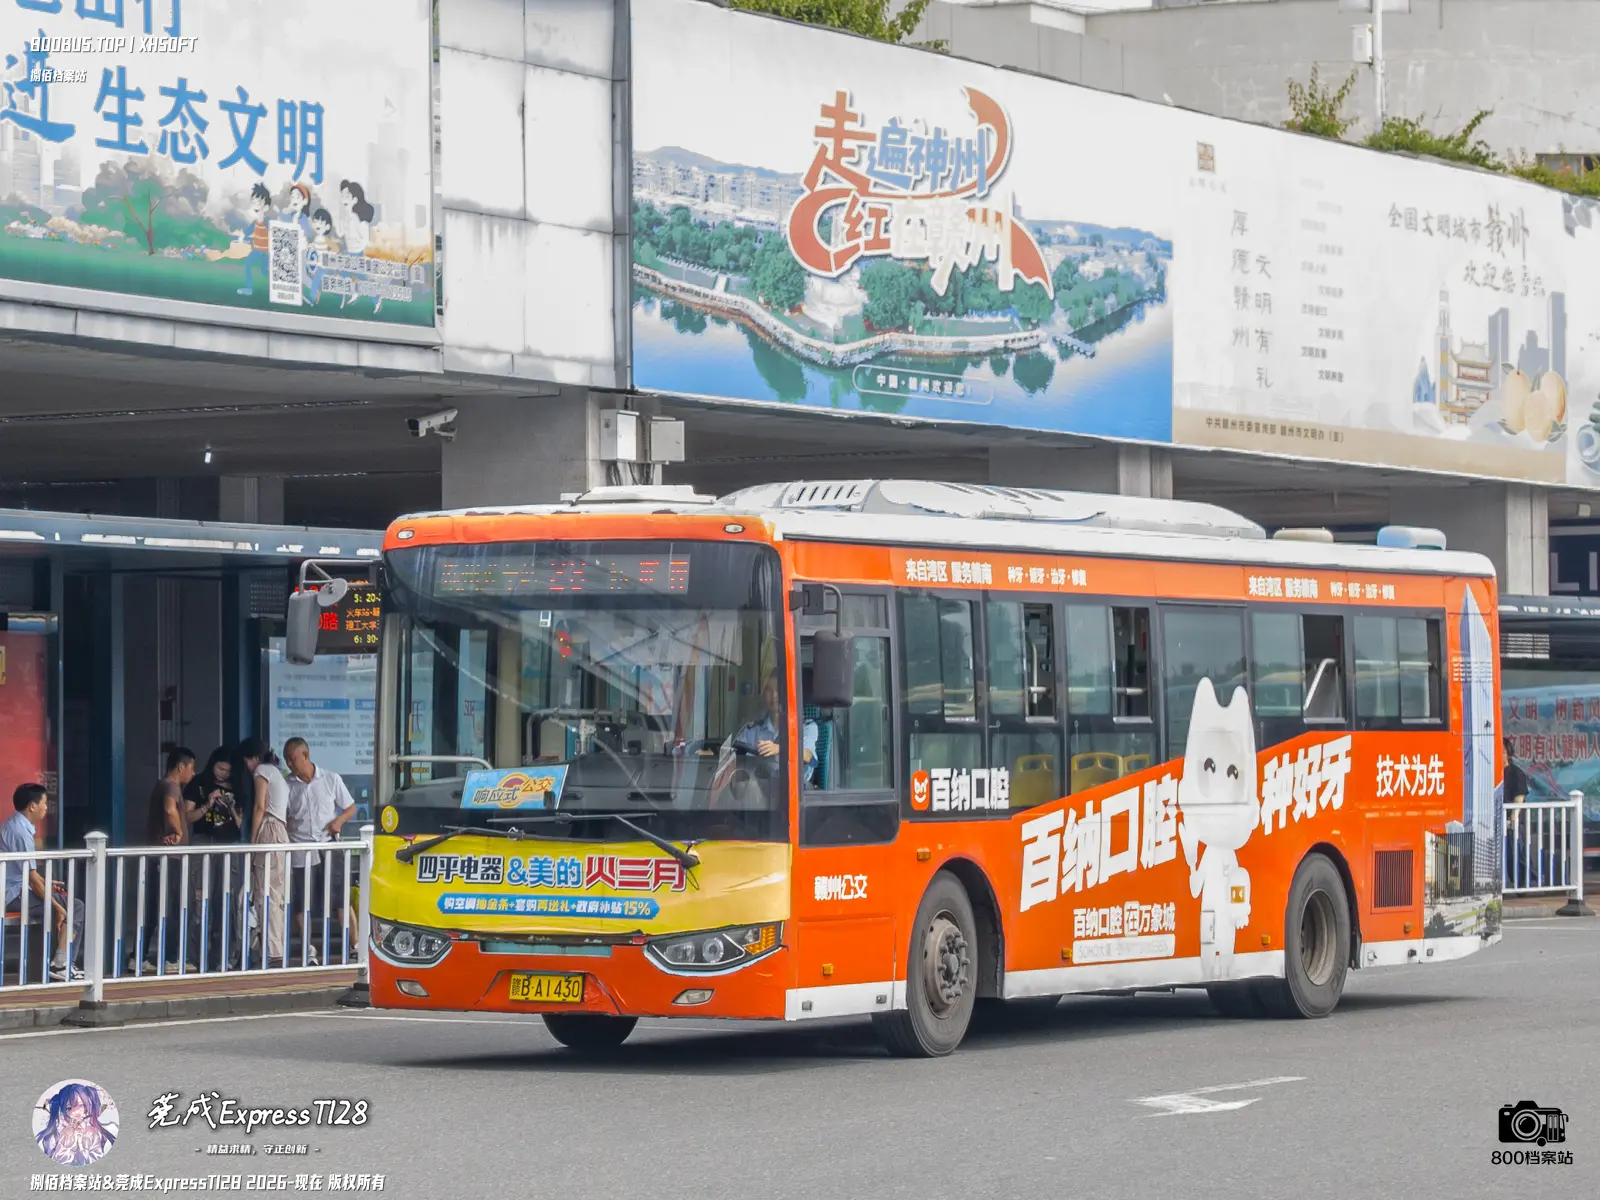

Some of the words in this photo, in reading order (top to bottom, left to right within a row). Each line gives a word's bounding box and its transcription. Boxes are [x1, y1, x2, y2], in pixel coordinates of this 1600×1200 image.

[94, 65, 325, 185] 生态文明
[317, 612, 339, 631] 路
[931, 767, 1010, 812] 百纳口腔
[1376, 753, 1445, 797] 技术为先
[1020, 774, 1180, 913] 百纳口腔
[1260, 735, 1352, 836] 种好牙
[814, 874, 868, 901] 赣州公交
